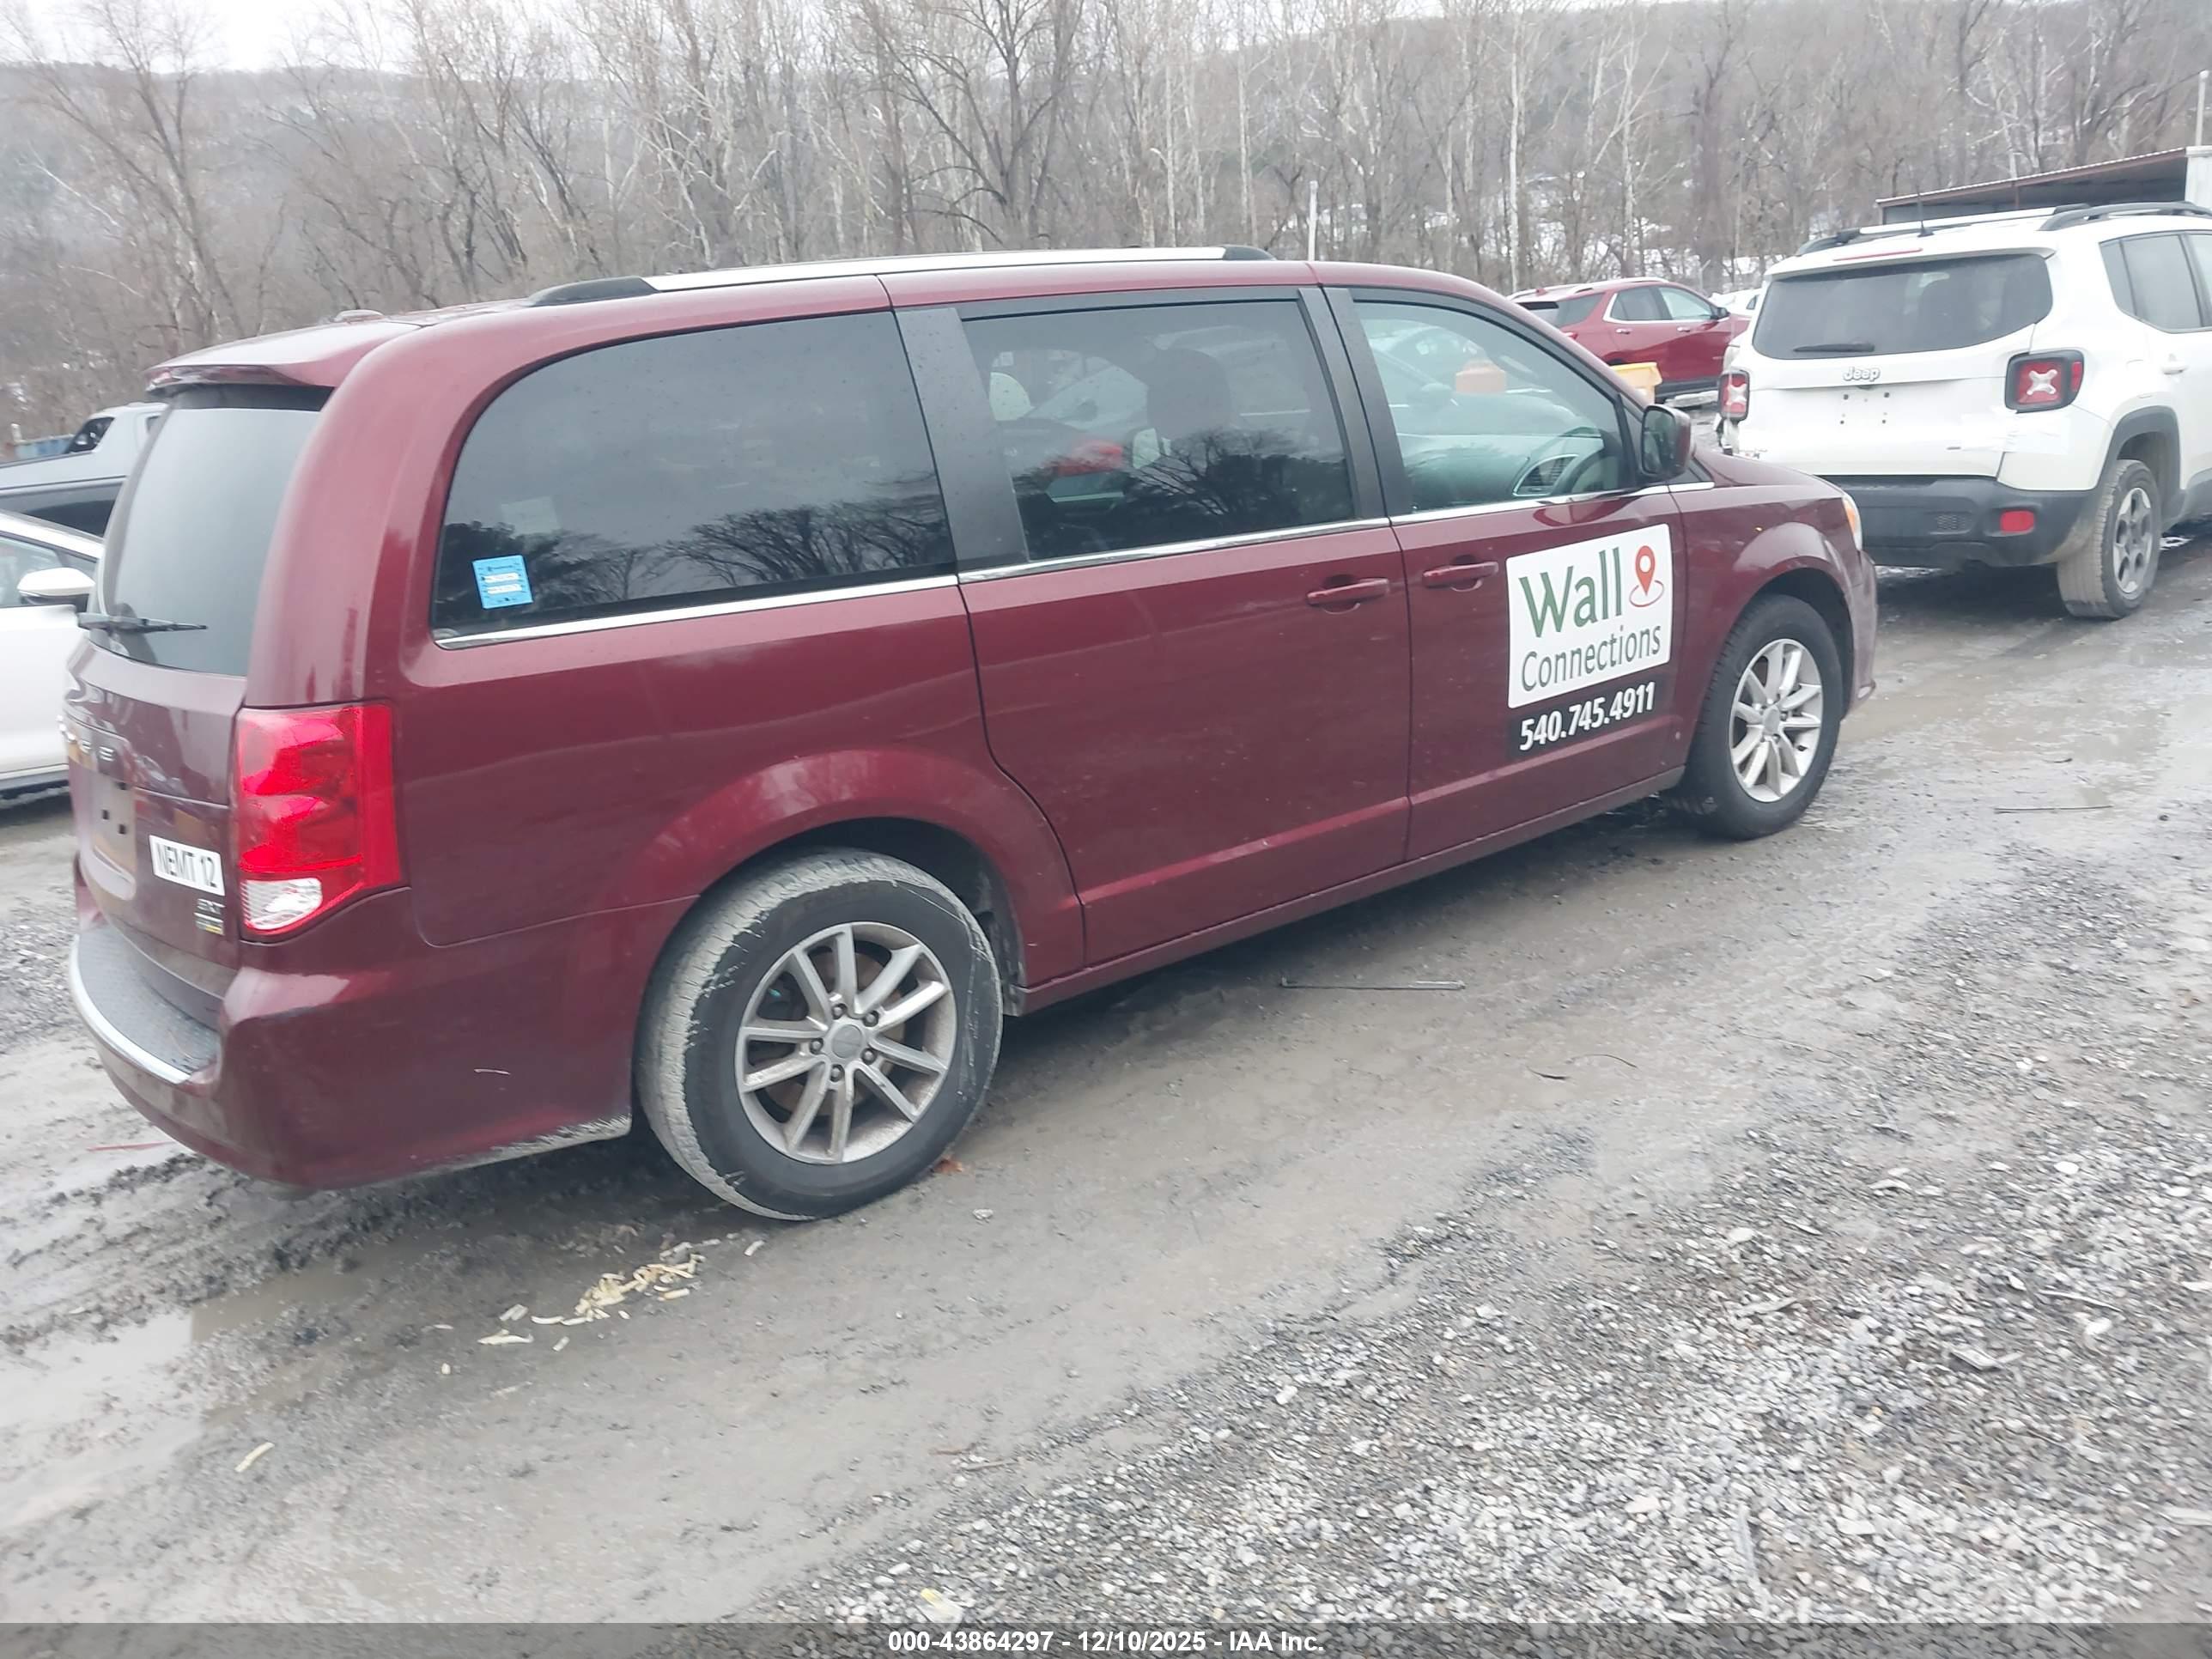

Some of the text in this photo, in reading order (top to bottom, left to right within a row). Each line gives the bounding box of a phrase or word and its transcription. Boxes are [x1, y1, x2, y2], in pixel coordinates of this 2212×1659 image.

[1843, 366, 1881, 382] Jeep
[1518, 547, 1622, 637] Wall
[1522, 625, 1661, 692] Connections
[1519, 682, 1656, 751] 540.745.4911
[155, 842, 217, 888] NEMT 12
